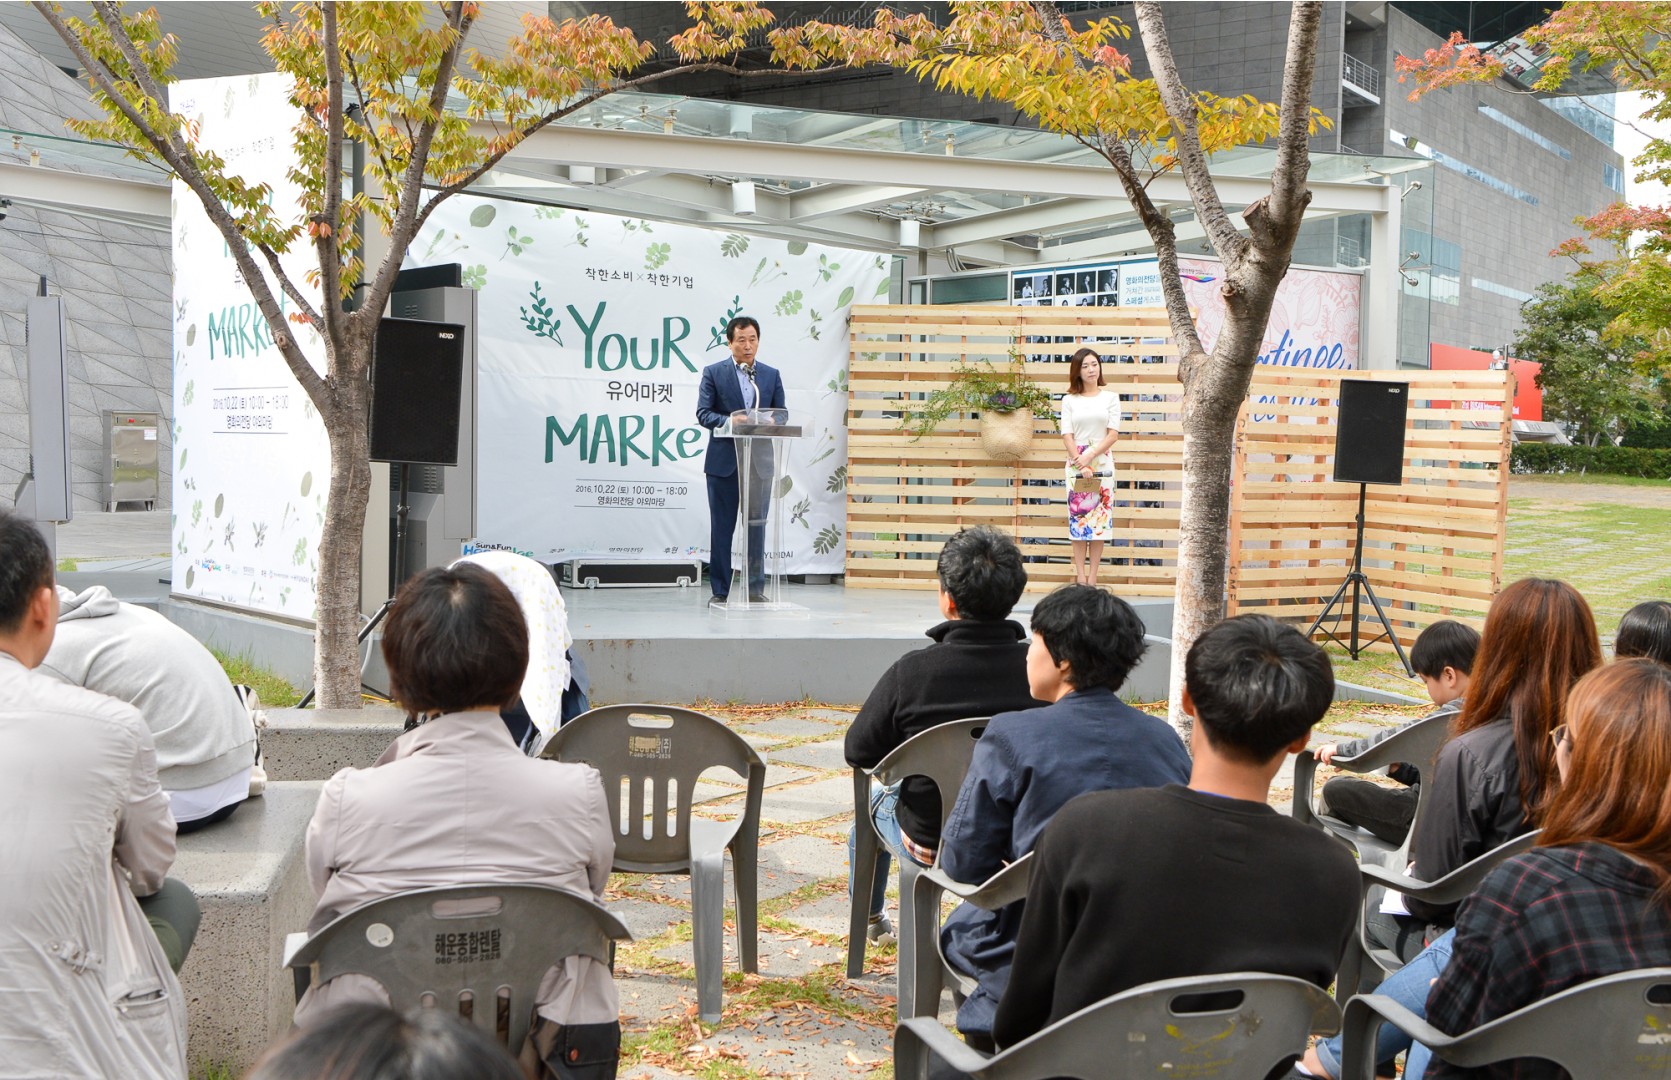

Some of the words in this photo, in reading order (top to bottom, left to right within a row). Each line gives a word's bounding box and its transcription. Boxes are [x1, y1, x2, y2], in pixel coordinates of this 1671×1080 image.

[585, 267, 633, 282] 착한소비
[647, 272, 693, 289] 착한기업
[606, 380, 673, 403] 유어마켓
[575, 484, 615, 494] 2016.10.22
[632, 485, 655, 495] 10:00
[665, 486, 688, 495] 18:00
[597, 496, 634, 506] 영화의전당
[636, 497, 665, 506] 야외마당
[475, 542, 512, 551] Sun&Fun
[435, 928, 502, 956] 해운종합렌탈
